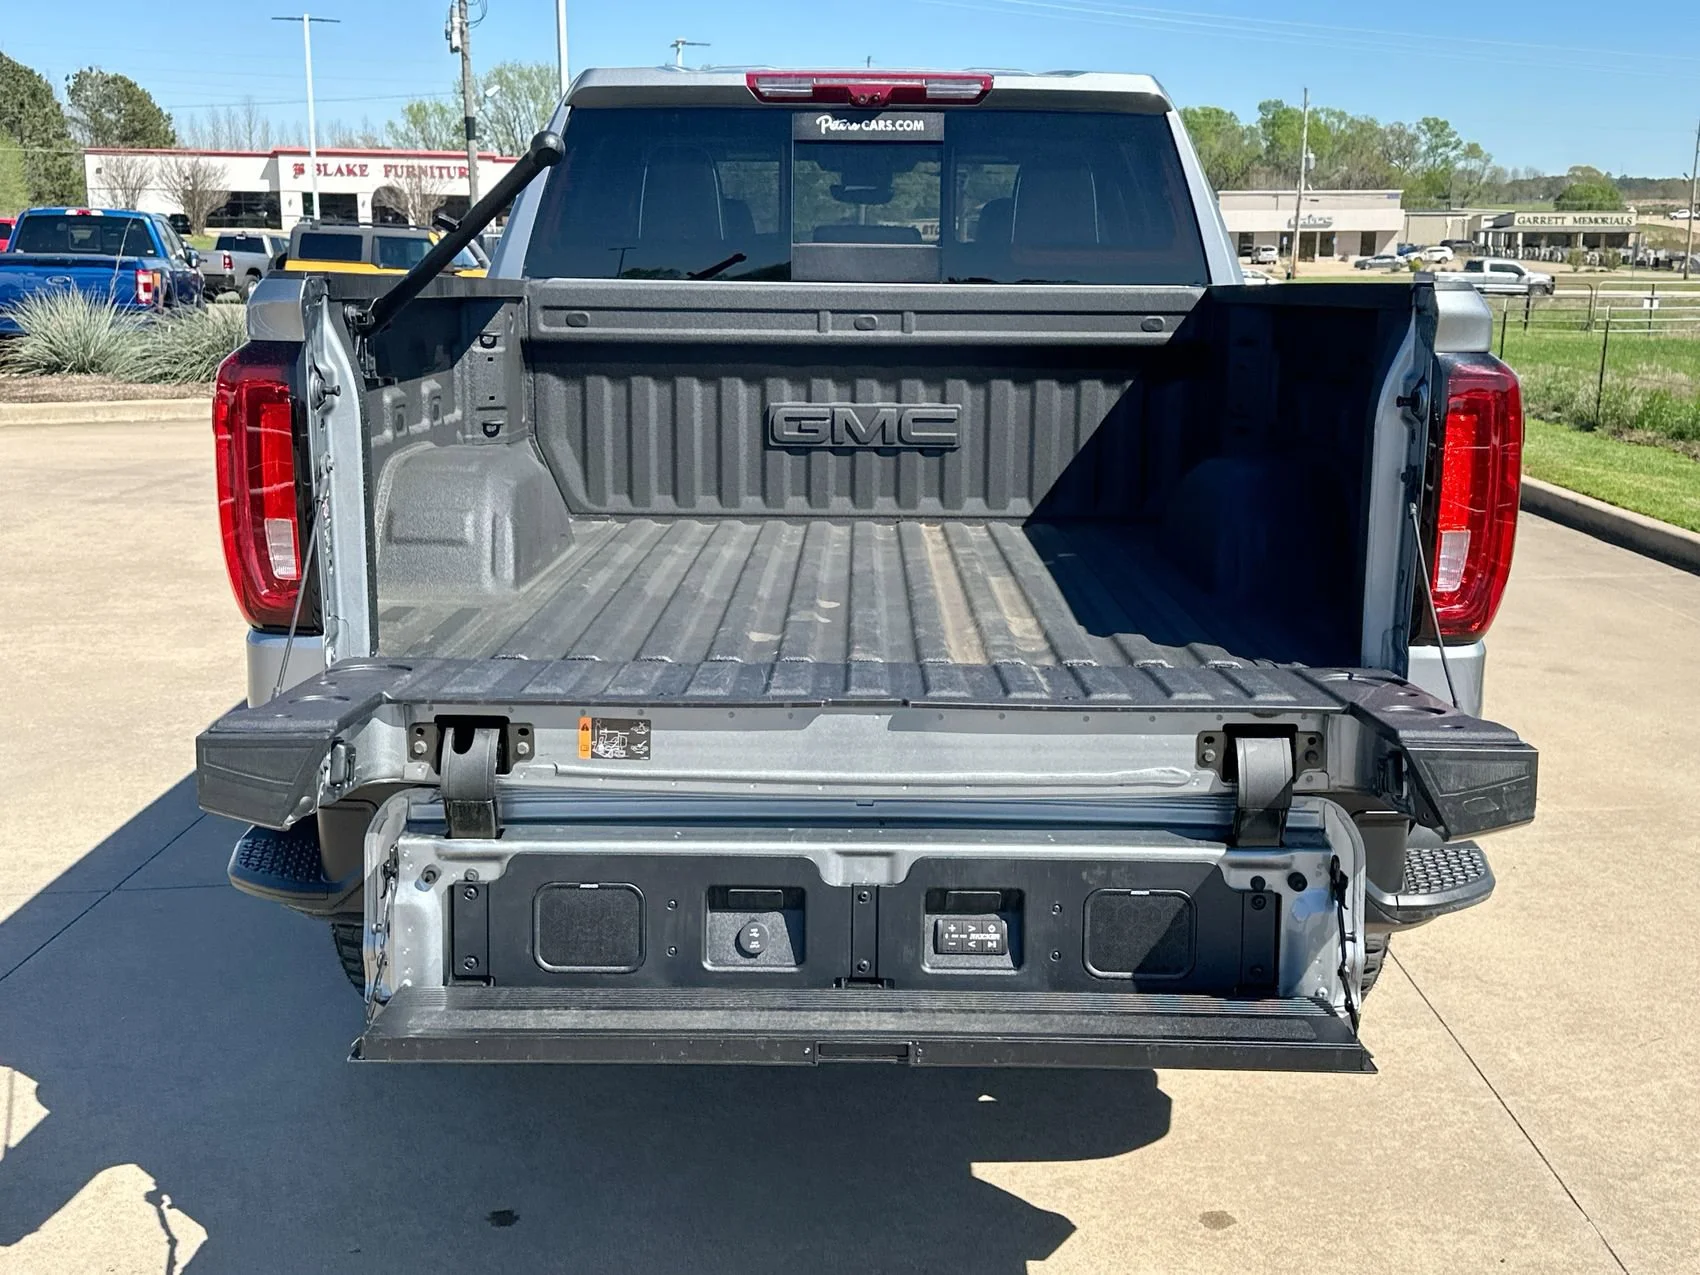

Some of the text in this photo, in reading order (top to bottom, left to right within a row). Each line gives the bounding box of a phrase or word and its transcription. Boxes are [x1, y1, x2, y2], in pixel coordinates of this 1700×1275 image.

[383, 164, 480, 179] FURNITUR
[1517, 216, 1633, 225] GARRETT MEMORIALS
[772, 407, 958, 445] GMC
